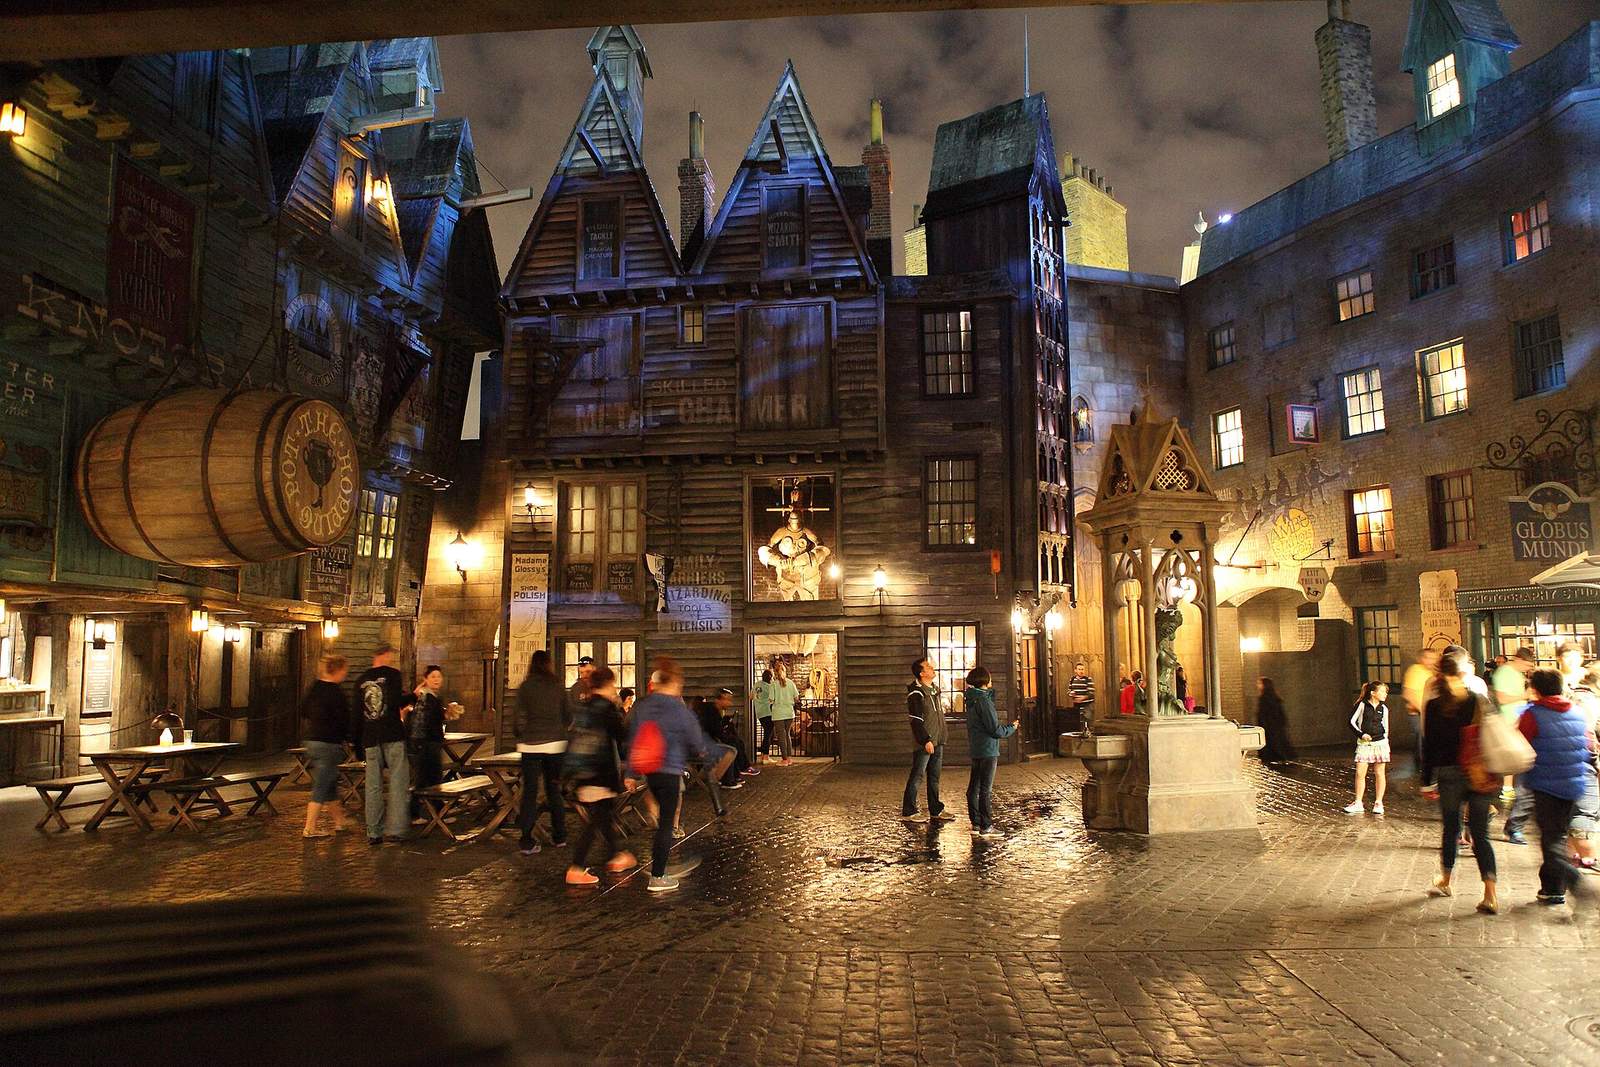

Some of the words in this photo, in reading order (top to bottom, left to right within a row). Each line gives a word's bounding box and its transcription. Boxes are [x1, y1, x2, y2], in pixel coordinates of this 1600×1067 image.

[299, 407, 342, 445] THE
[300, 449, 353, 538] HOPPING
[1516, 521, 1590, 540] GLOBUS
[1521, 540, 1586, 559] MUNDI
[669, 571, 727, 585] ARRIERS
[513, 592, 546, 600] POLISH
[667, 586, 730, 604] IZARDING
[1468, 590, 1557, 605] PHOTOGRAPHY
[679, 604, 712, 613] TOOLS
[670, 620, 723, 632] UTENSILS
